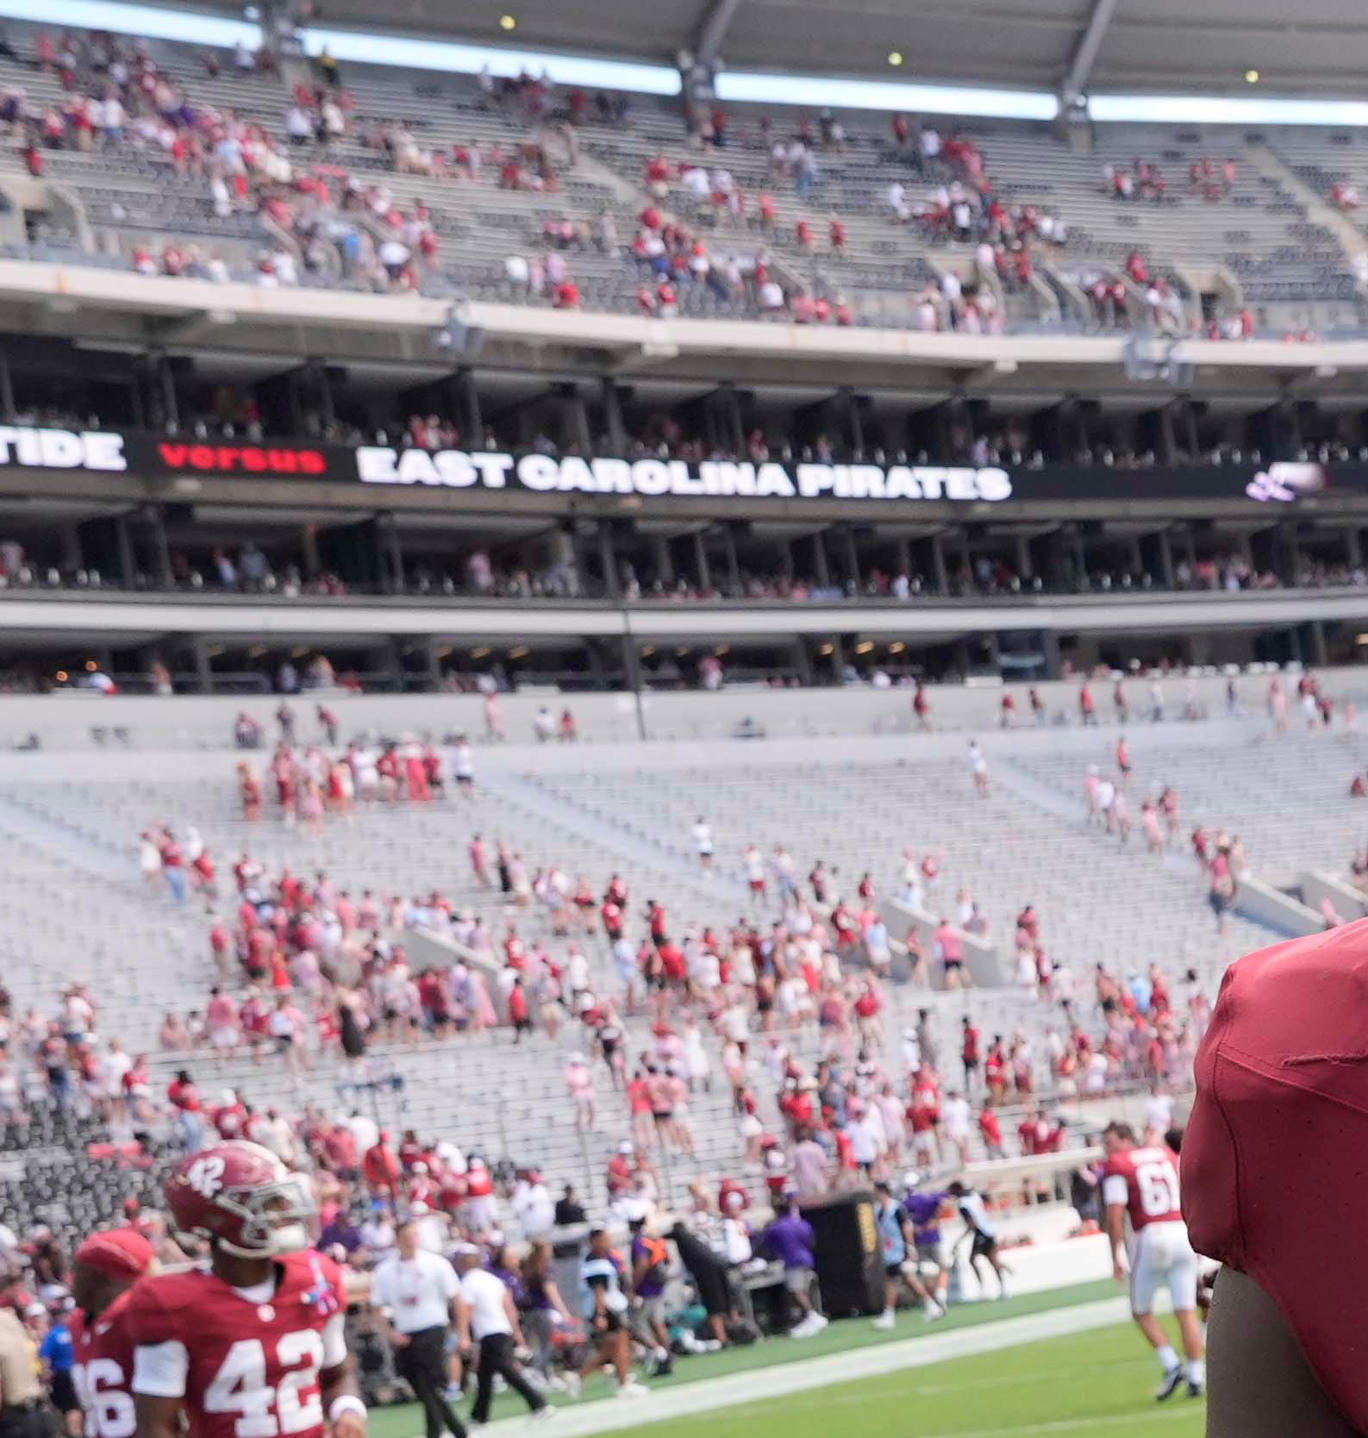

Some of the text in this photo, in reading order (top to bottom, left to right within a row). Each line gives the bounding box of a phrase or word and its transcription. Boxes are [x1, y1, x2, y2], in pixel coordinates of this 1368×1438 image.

[158, 442, 327, 474] versus
[355, 446, 514, 488] EAST
[516, 453, 796, 497] CAROLINA
[797, 463, 1012, 501] PIRATES
